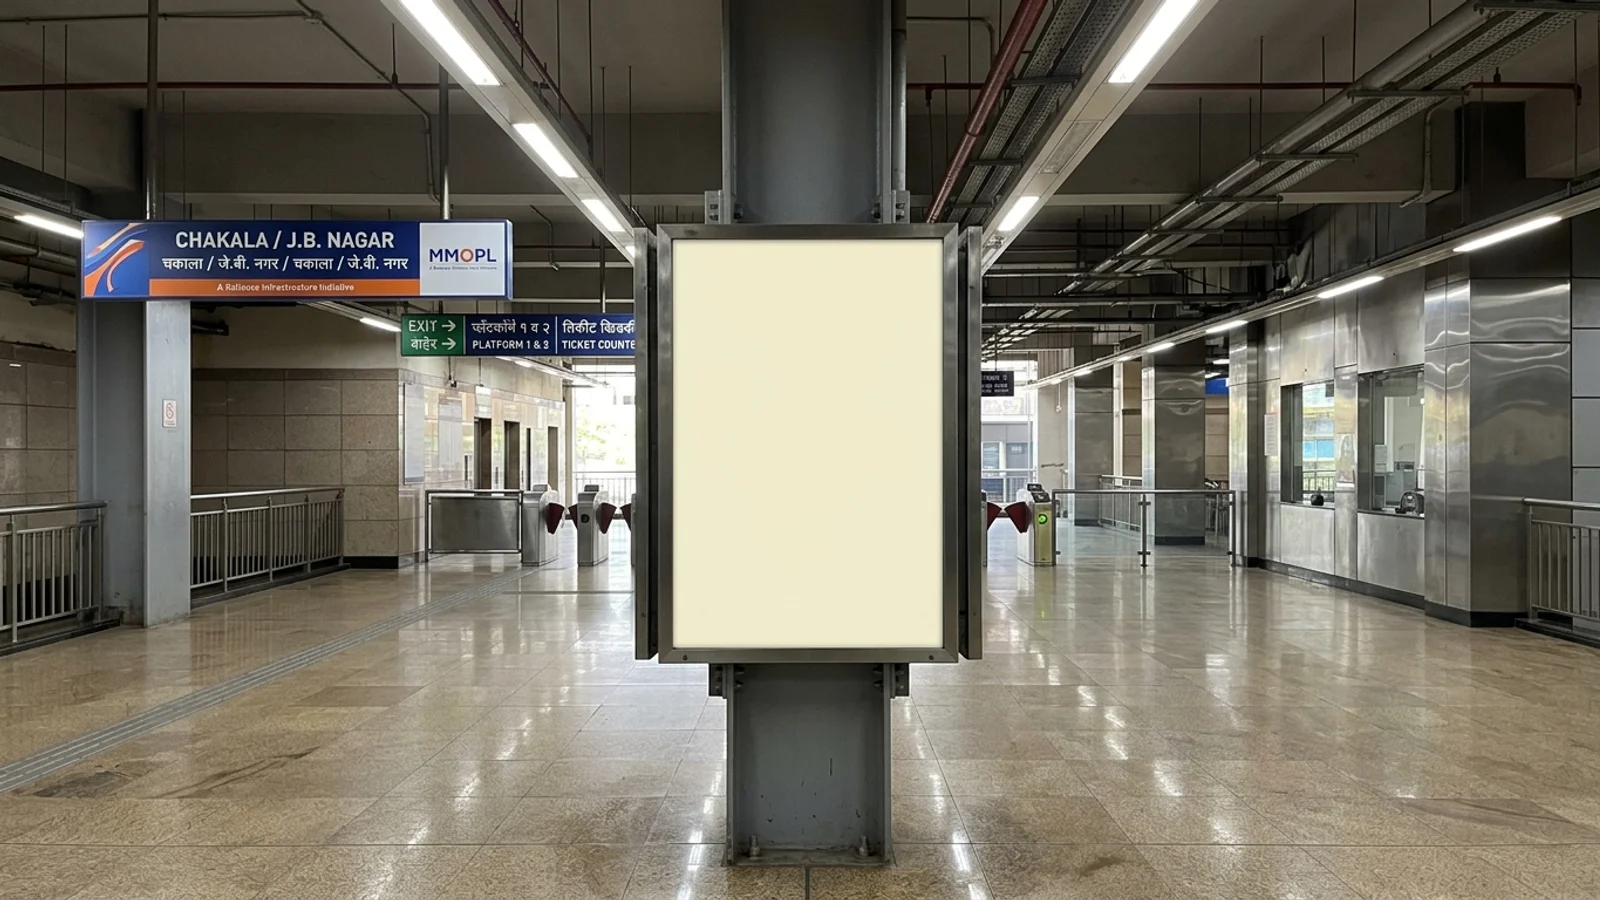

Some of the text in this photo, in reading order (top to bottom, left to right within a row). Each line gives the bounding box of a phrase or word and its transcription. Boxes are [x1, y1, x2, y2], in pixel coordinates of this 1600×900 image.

[175, 230, 395, 250] CHAKALA / J.B. NAGAR
[162, 257, 203, 270] चकाला
[206, 255, 215, 271] /
[254, 257, 279, 270] नगर
[282, 255, 290, 271] /
[293, 257, 334, 270] चकाला
[336, 255, 345, 271] /
[383, 257, 409, 270] नगर
[429, 248, 497, 263] MMOPL
[472, 340, 524, 350] PLATFORM
[533, 340, 542, 350] &
[562, 340, 596, 350] TICKET
